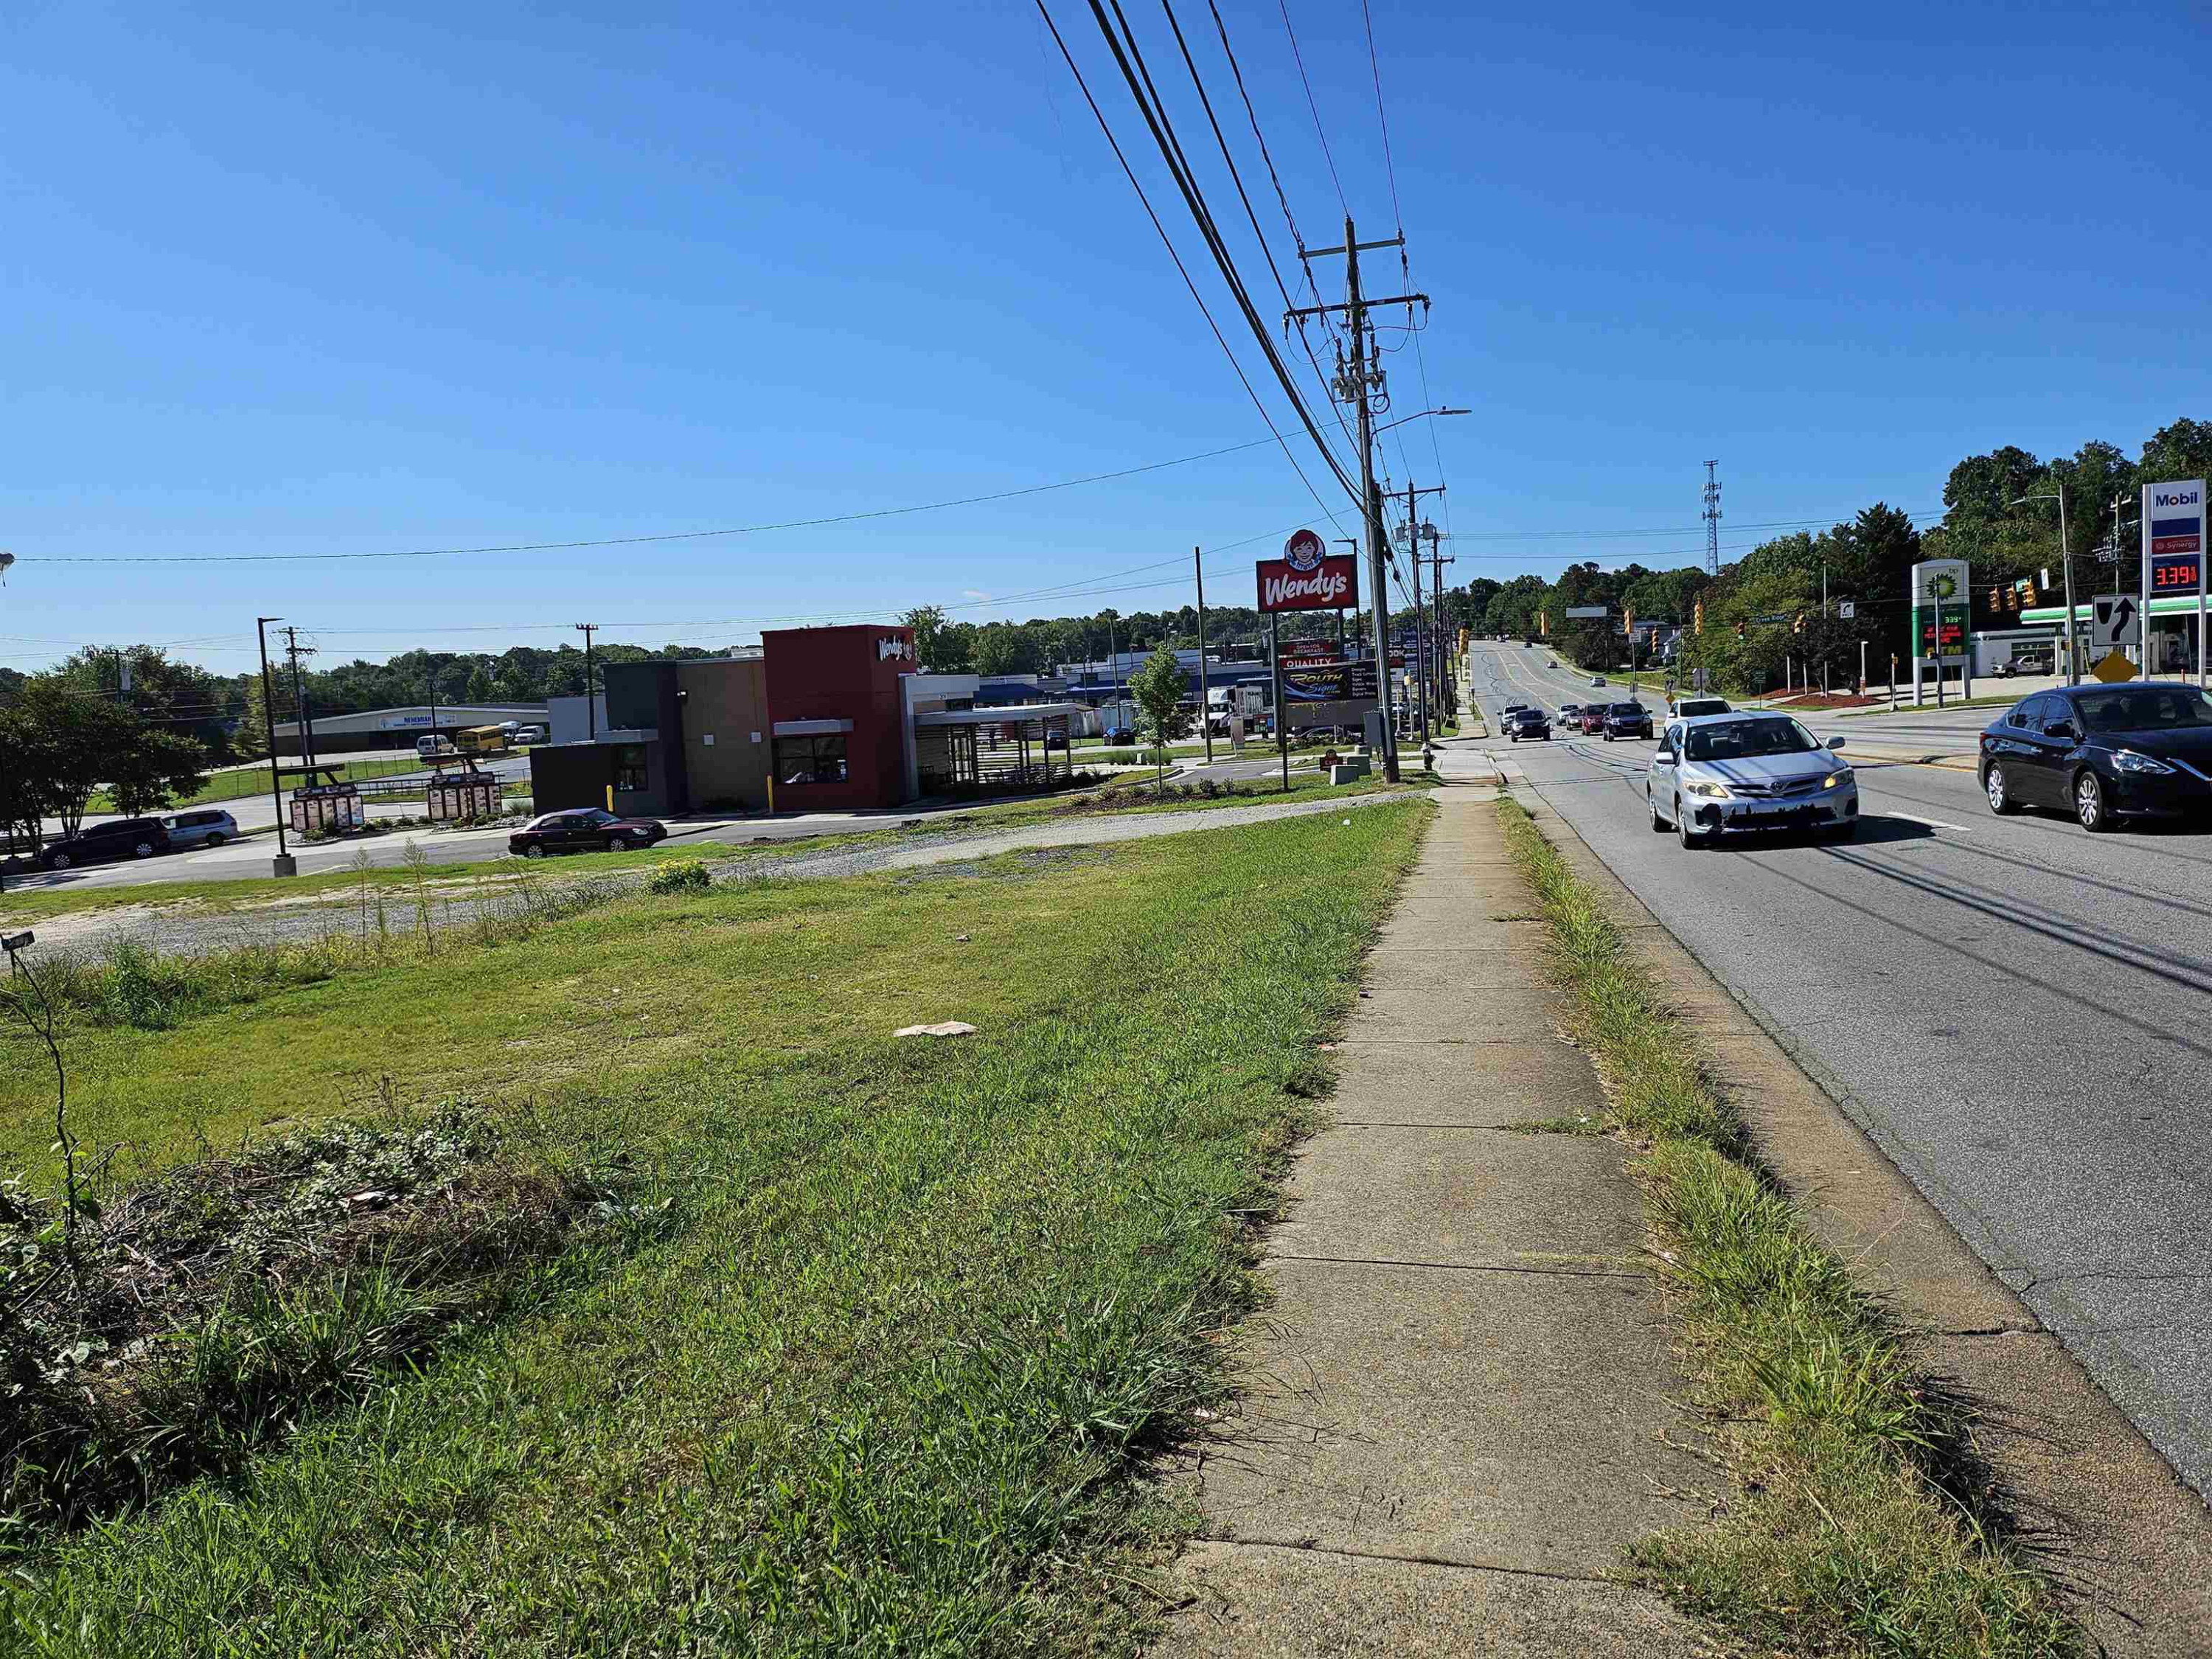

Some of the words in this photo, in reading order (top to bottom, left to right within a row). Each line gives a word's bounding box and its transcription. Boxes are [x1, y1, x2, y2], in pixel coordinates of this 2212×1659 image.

[2155, 492, 2197, 507] Mobil
[2167, 541, 2197, 550] Synergy
[2156, 566, 2189, 585] 3.39
[1265, 568, 1347, 606] Wendy's
[879, 635, 902, 661] Wendy's
[1287, 658, 1332, 667] QUALITY
[1290, 673, 1342, 683] ROUTH
[1308, 683, 1338, 694] Signs
